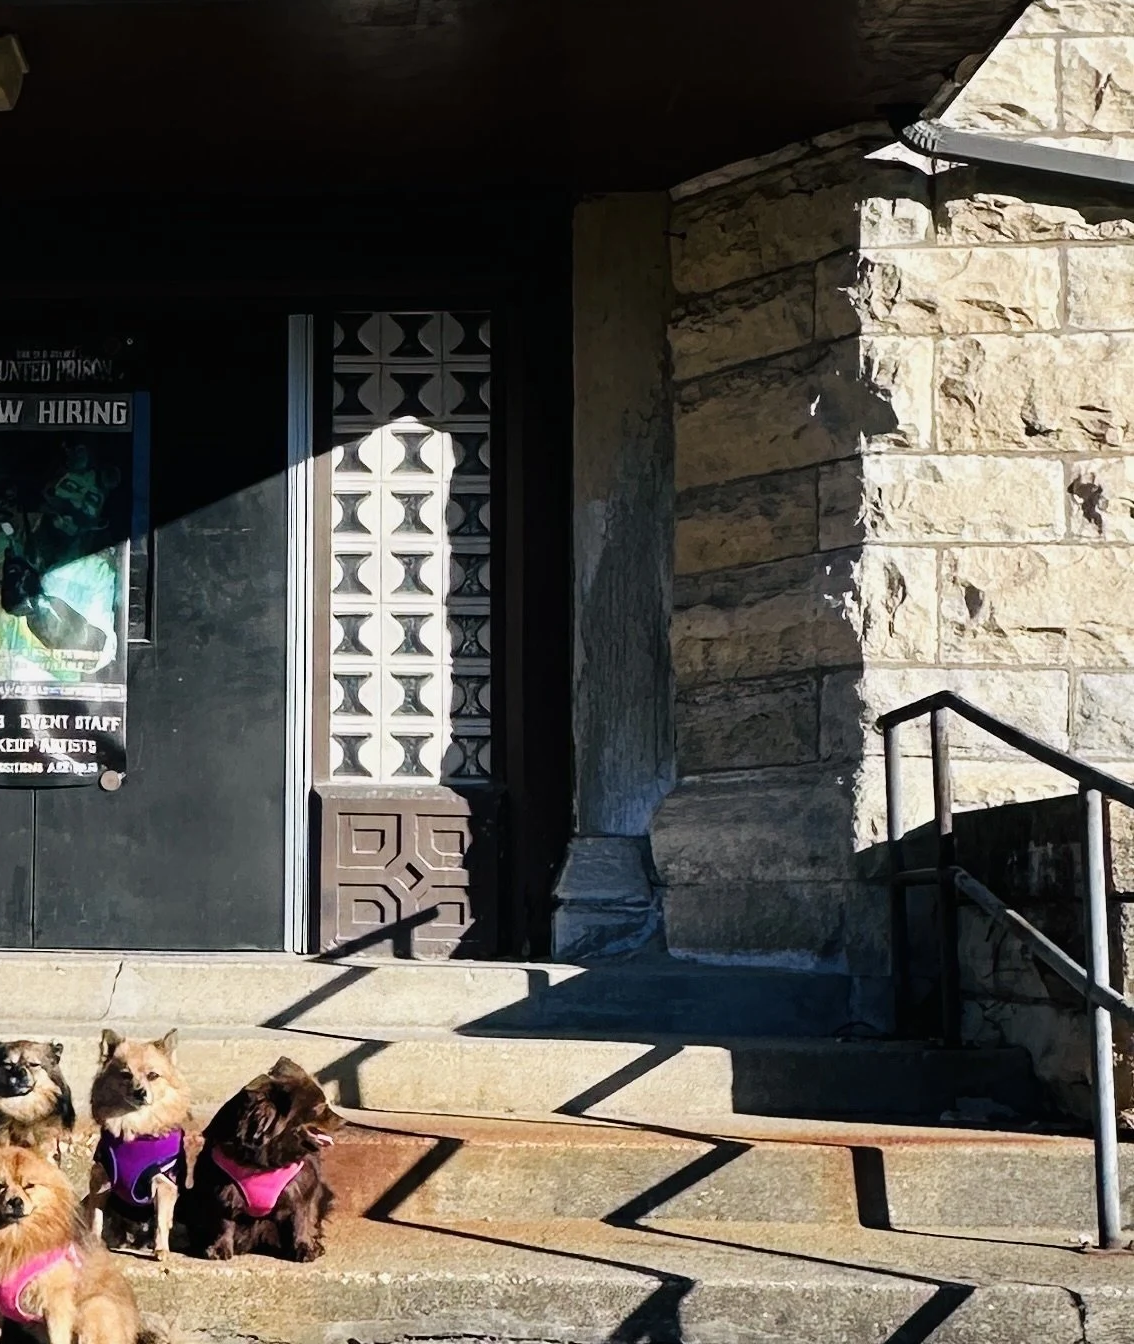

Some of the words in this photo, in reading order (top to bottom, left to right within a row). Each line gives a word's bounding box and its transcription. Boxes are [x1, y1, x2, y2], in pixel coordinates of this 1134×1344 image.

[56, 358, 114, 382] PRISON
[38, 399, 128, 425] HIRING
[19, 714, 69, 730] EVENT
[74, 715, 122, 732] STAFF
